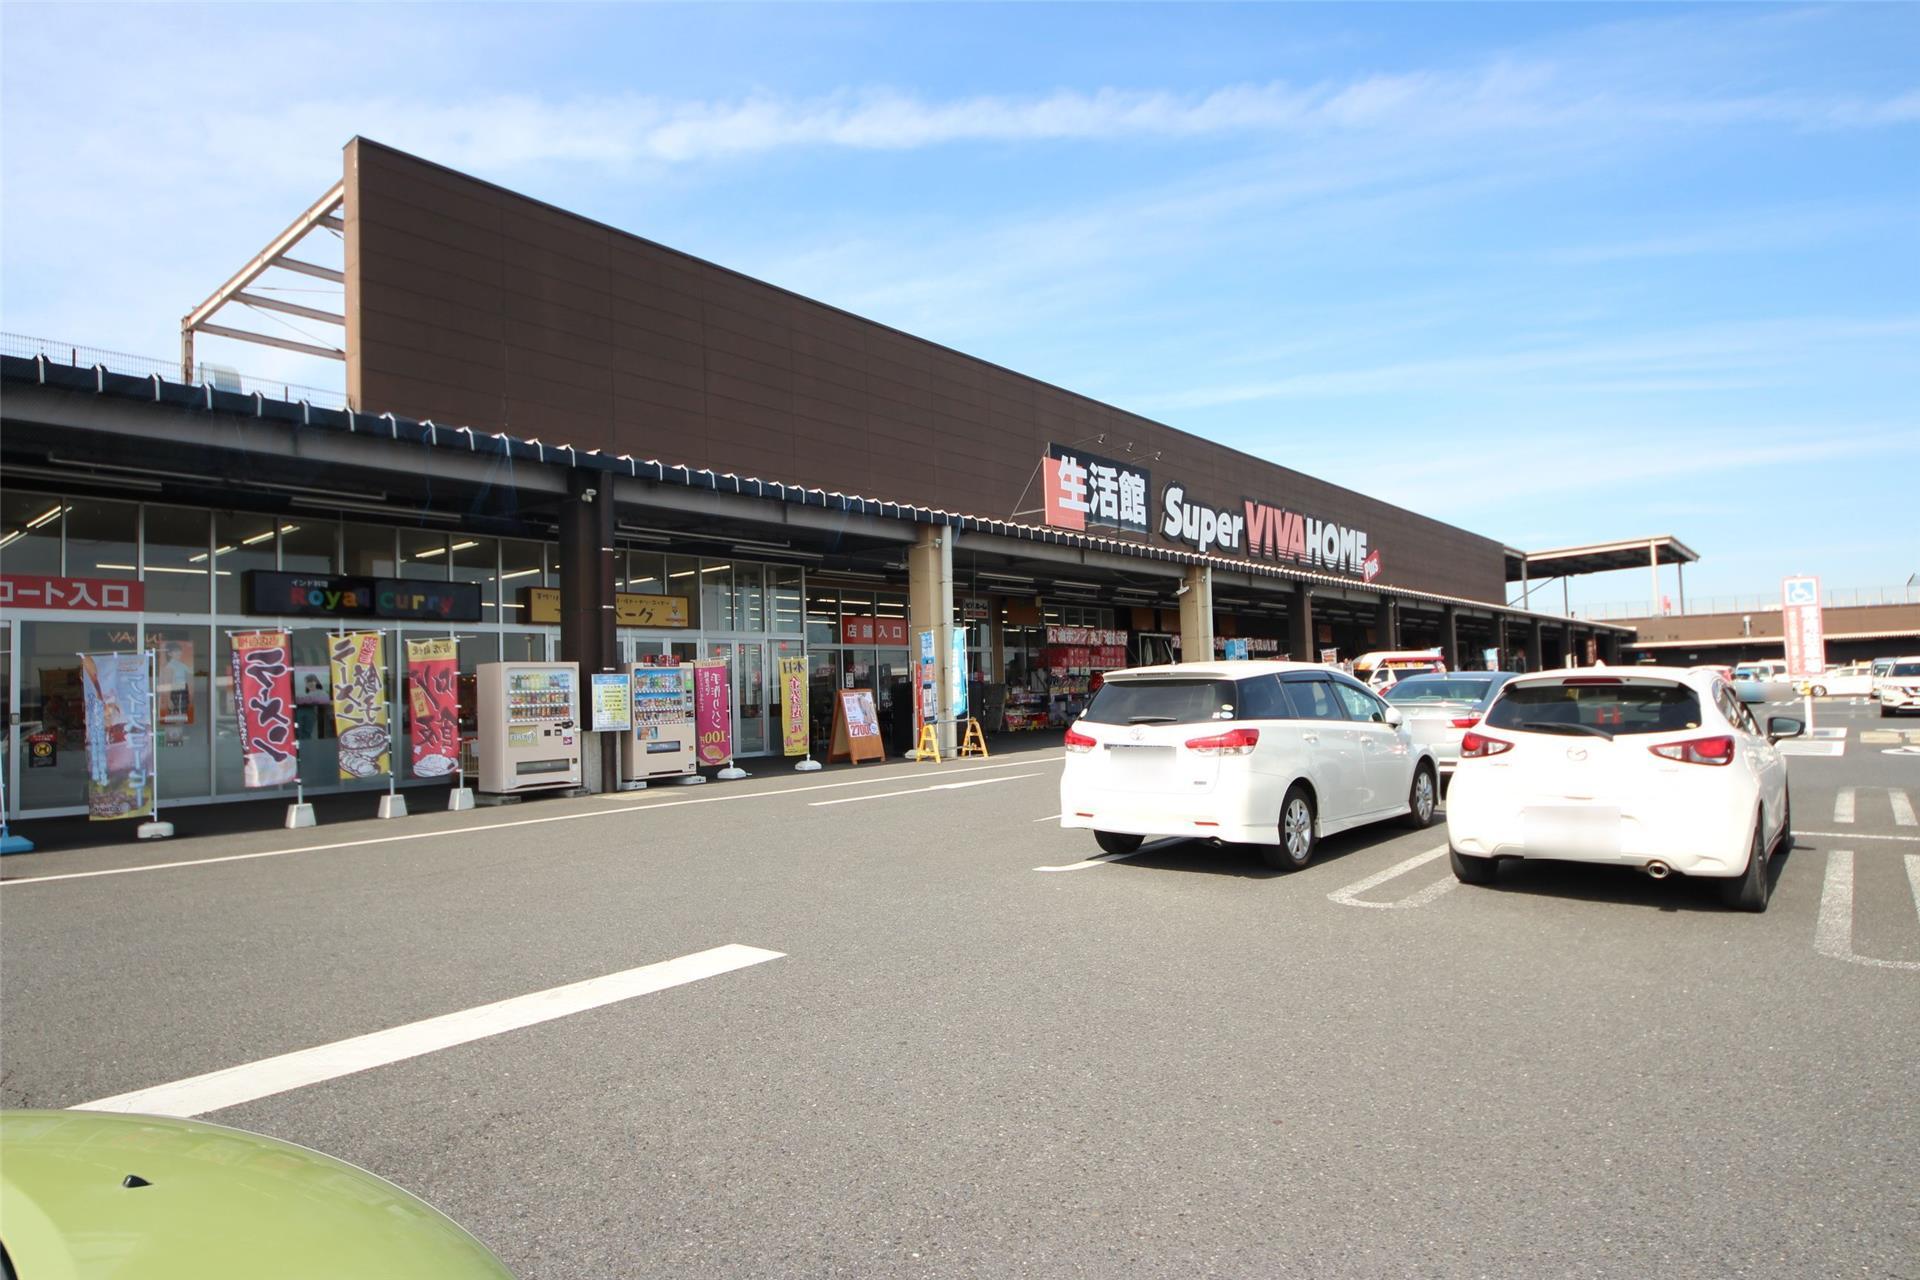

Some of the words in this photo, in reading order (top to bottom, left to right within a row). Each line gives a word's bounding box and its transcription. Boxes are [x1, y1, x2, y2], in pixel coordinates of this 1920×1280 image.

[1058, 454, 1147, 526] 生活館
[1164, 486, 1243, 551] Super
[290, 587, 370, 609] Royal
[847, 624, 902, 639] 店舗入口
